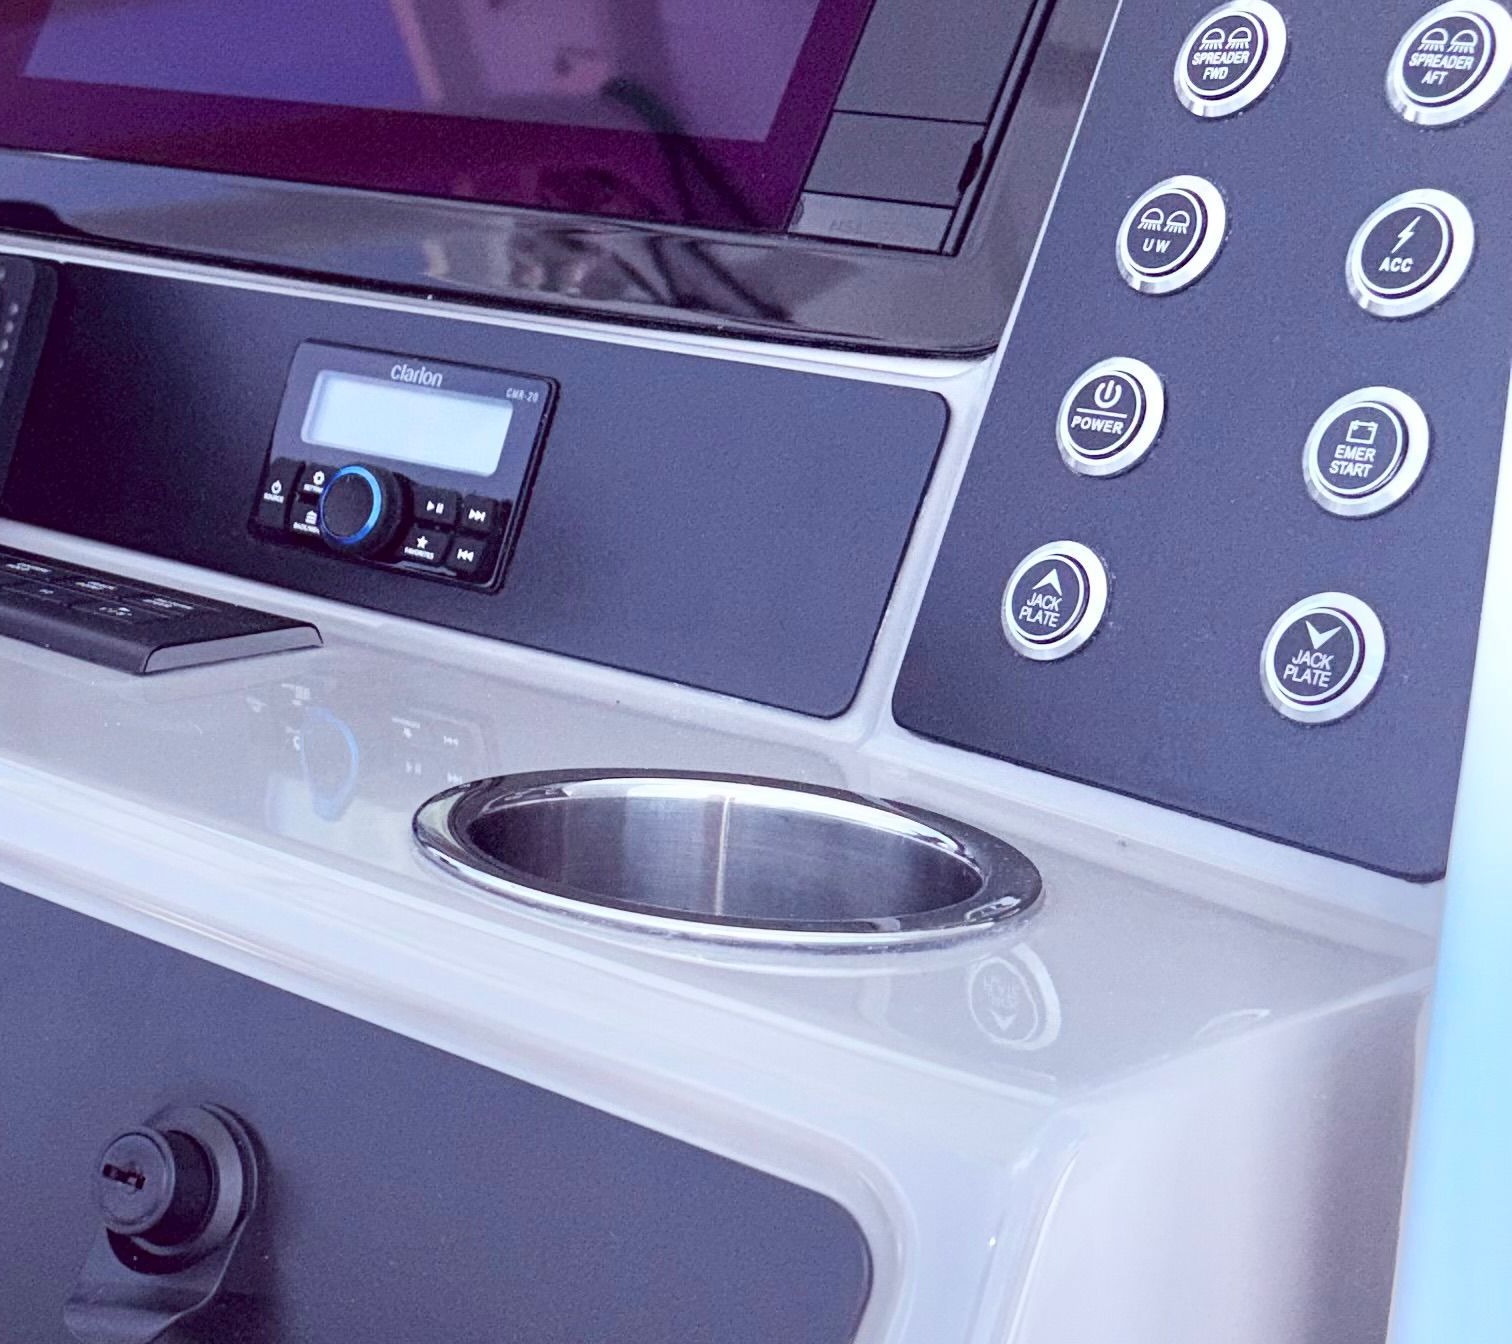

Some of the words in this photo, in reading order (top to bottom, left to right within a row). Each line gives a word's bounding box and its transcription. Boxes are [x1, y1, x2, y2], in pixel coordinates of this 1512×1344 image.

[1191, 51, 1251, 66] SPREADER
[1408, 52, 1474, 71] SPREADER
[1202, 66, 1230, 80] FWD
[1420, 69, 1449, 86] AFT
[1378, 256, 1414, 273] ACC
[390, 363, 443, 388] Clarion
[1070, 415, 1124, 436] POWER
[1334, 444, 1376, 463] EMER
[1329, 459, 1373, 478] START
[1026, 592, 1063, 612] JACK
[1018, 605, 1060, 628] PLATE
[1291, 649, 1335, 670] JACK
[1283, 663, 1332, 688] PLATE
